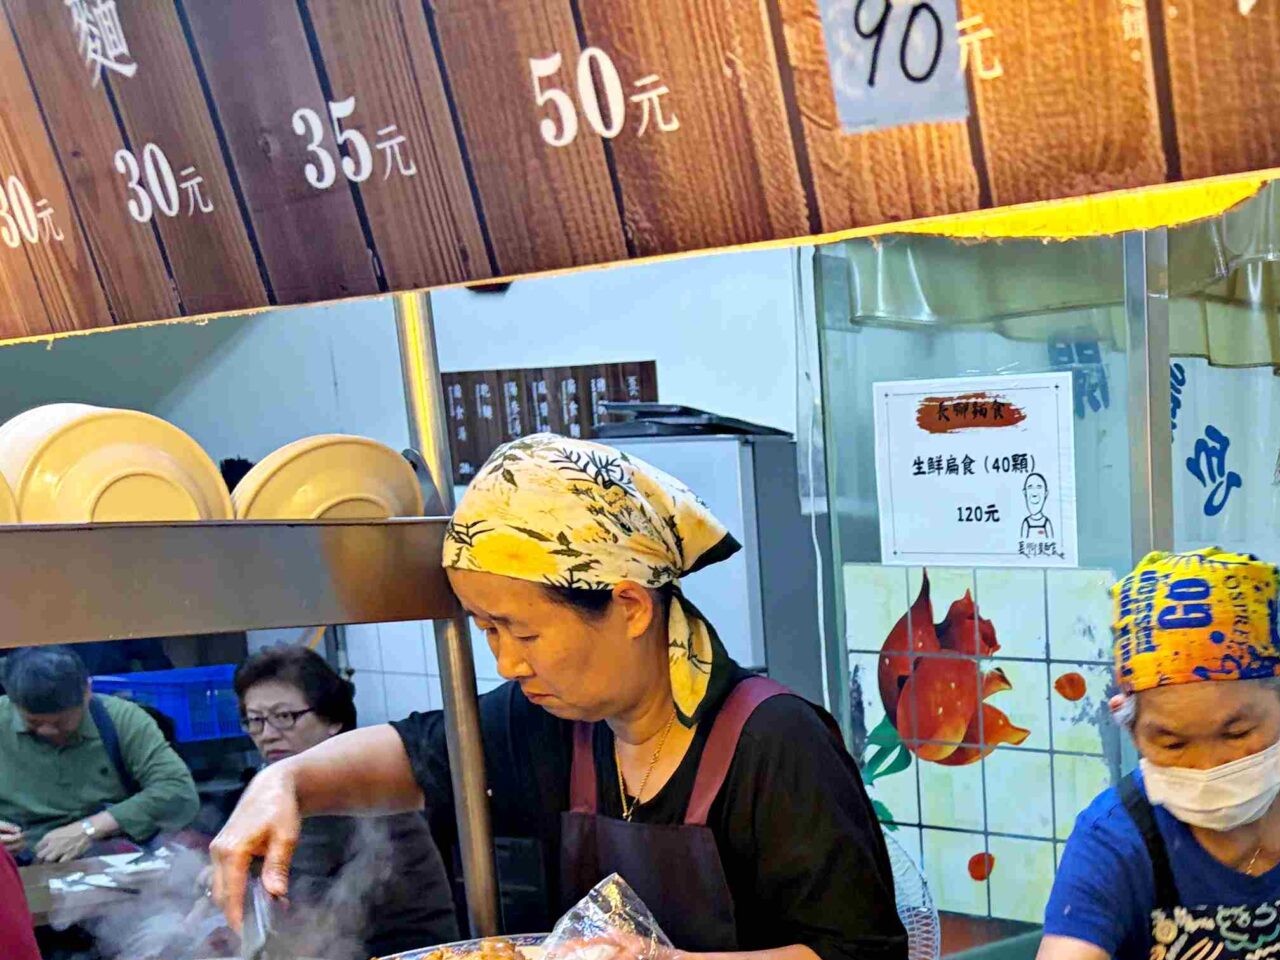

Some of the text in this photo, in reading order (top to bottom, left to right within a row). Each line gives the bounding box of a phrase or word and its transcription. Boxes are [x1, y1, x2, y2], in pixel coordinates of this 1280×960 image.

[529, 46, 680, 148] 50元
[114, 142, 214, 223] 30元
[292, 96, 417, 190] 35元
[957, 504, 1001, 523] 120元
